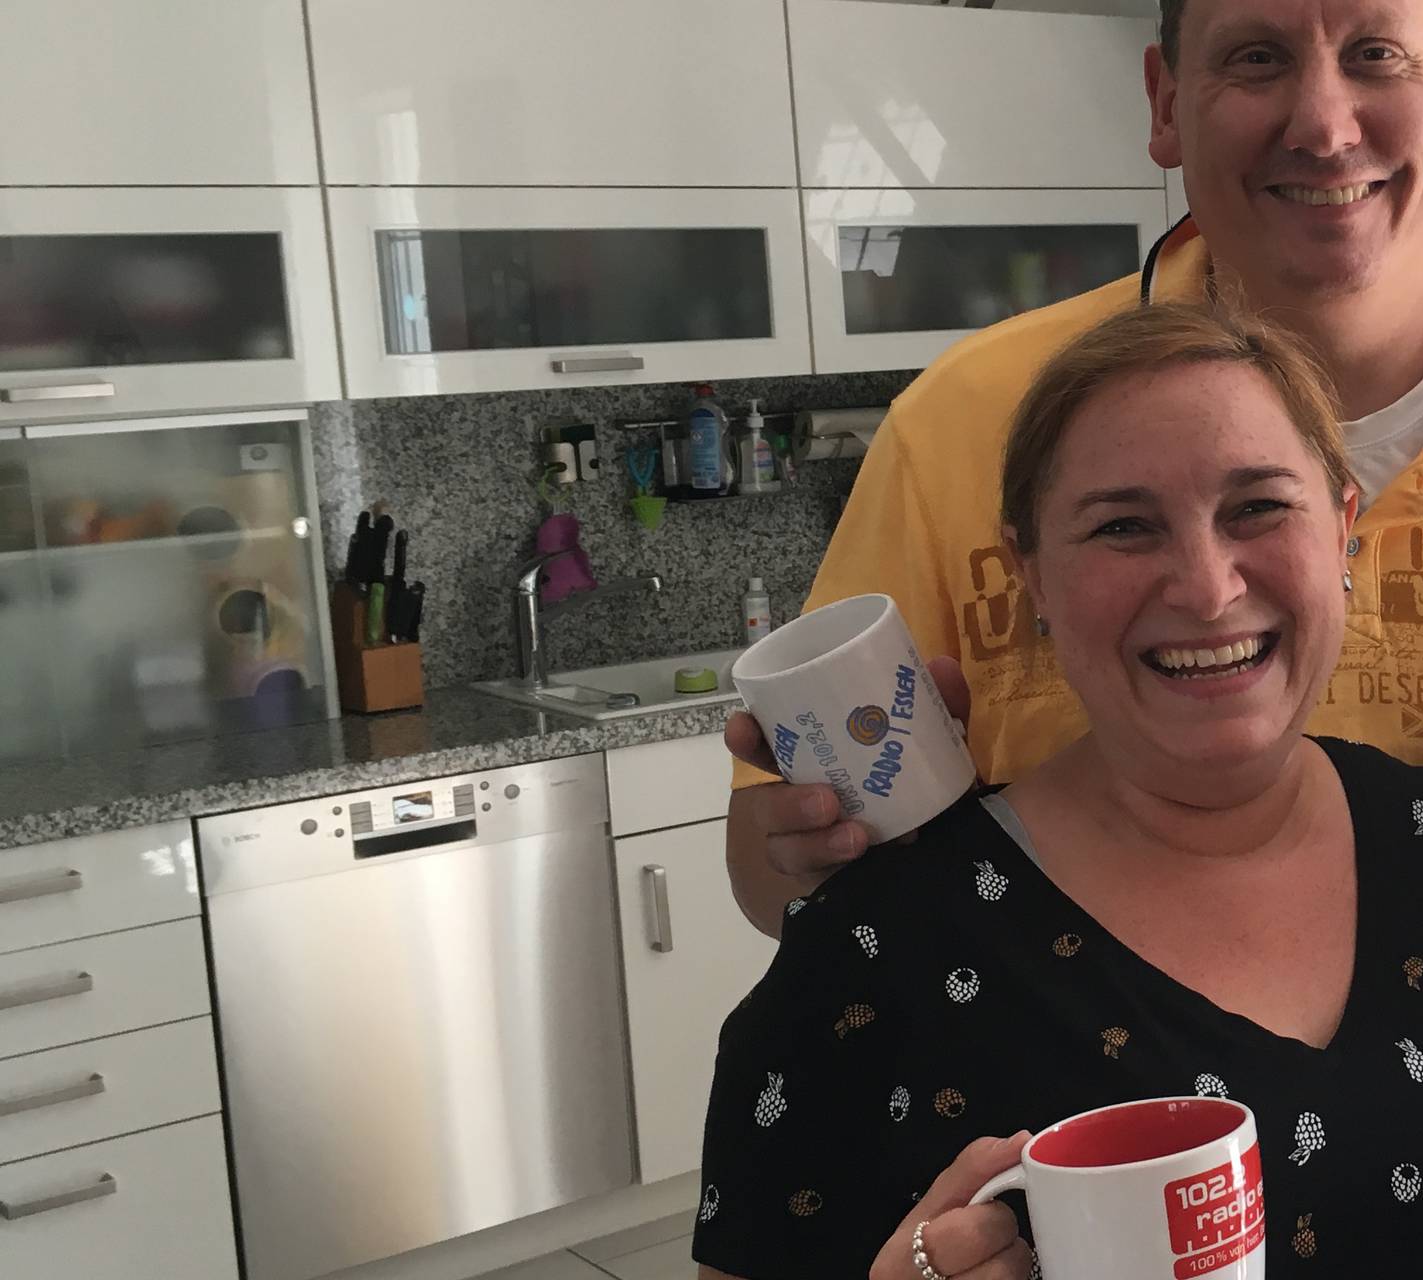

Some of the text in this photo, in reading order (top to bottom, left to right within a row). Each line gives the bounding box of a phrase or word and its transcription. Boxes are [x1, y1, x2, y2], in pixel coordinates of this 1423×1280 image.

[861, 663, 916, 798] RADIO ESSEN
[1196, 1187, 1256, 1231] radio
